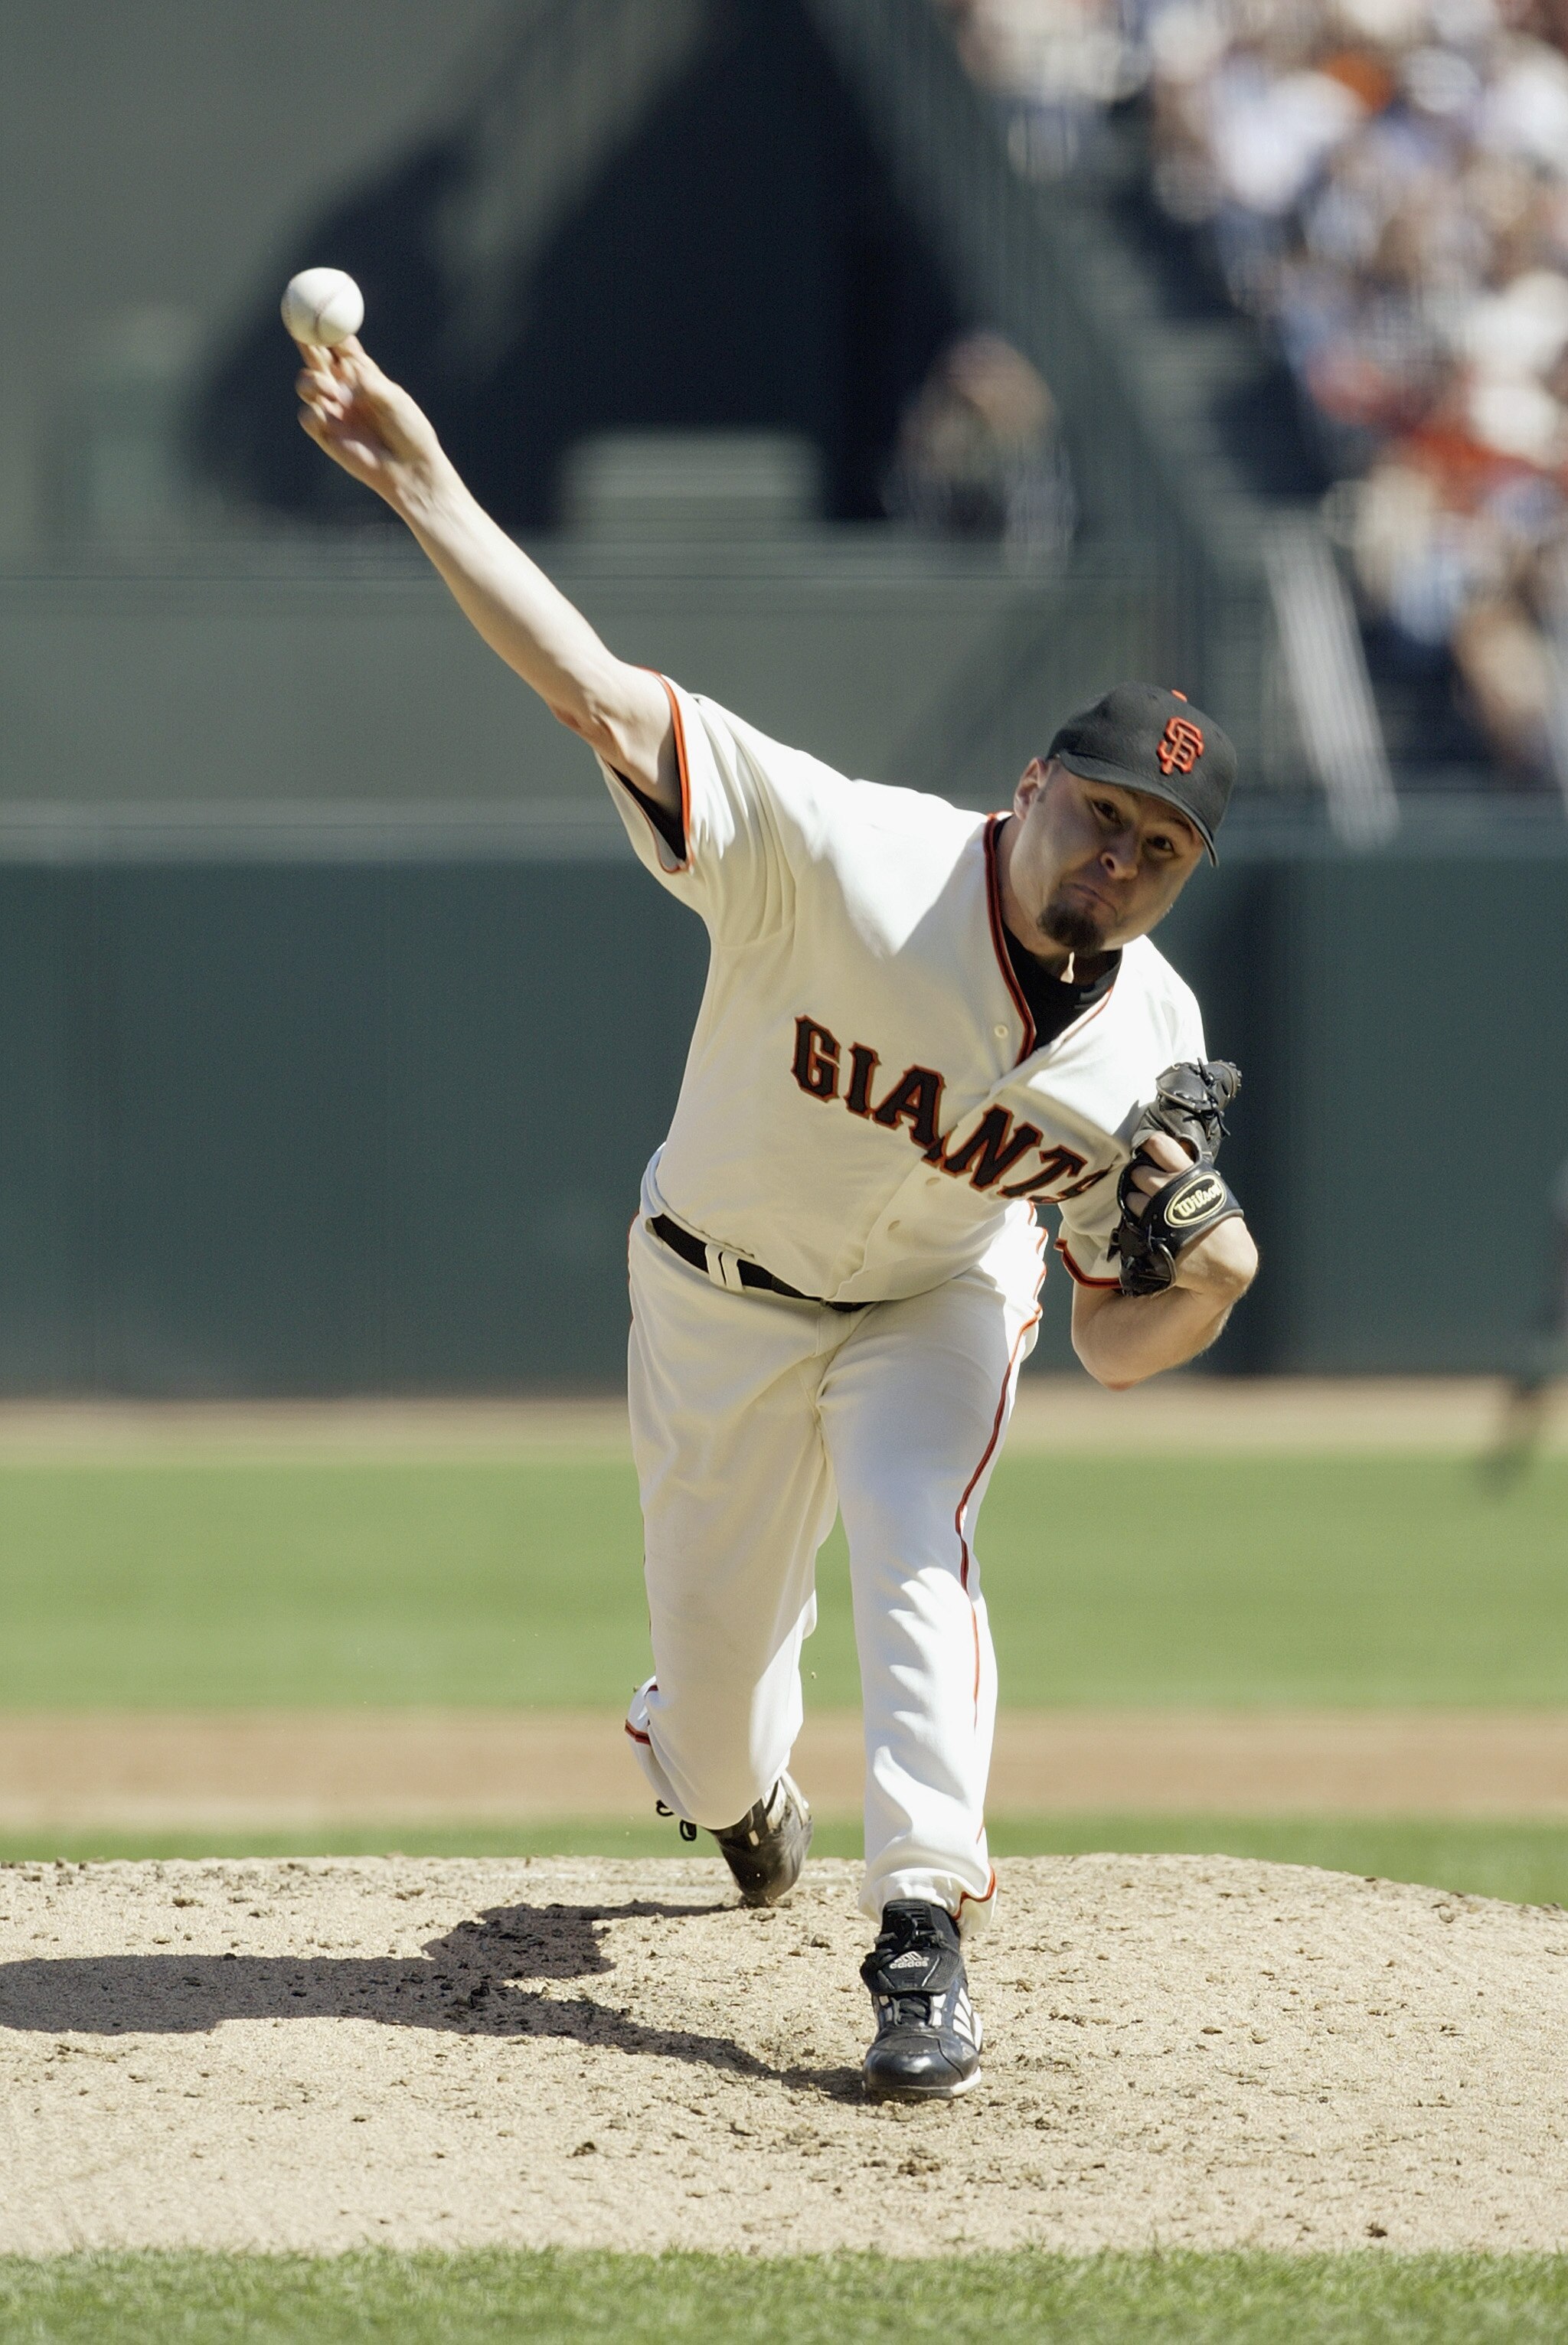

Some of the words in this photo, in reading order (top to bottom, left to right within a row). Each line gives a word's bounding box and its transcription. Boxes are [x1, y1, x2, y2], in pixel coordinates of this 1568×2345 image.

[1157, 716, 1204, 776] SF
[1174, 1182, 1222, 1217] Wilson
[889, 1958, 928, 1969] adidas
